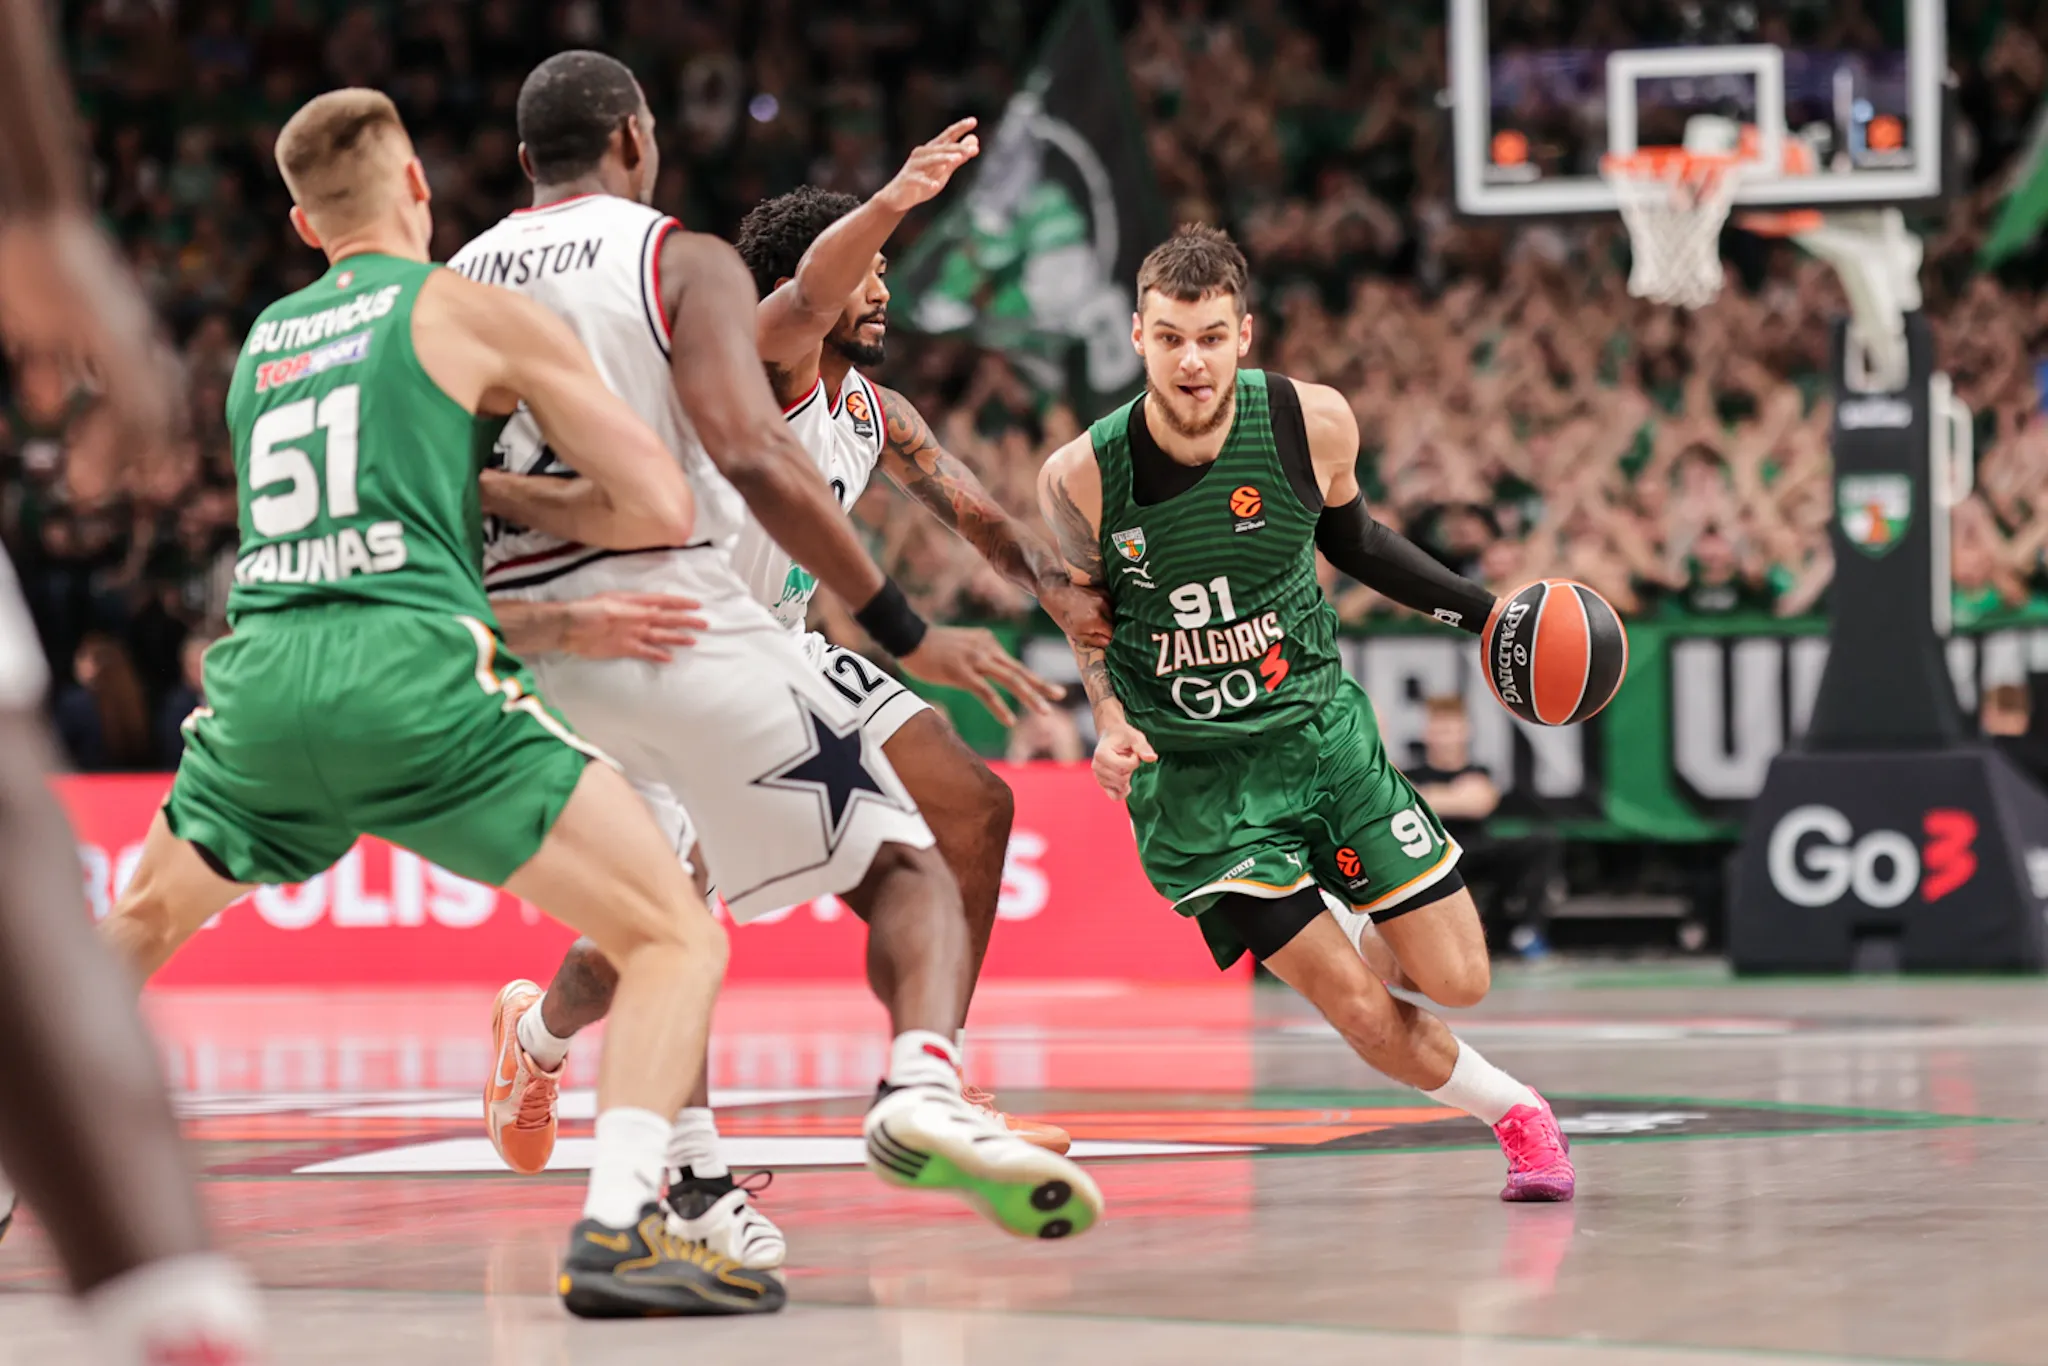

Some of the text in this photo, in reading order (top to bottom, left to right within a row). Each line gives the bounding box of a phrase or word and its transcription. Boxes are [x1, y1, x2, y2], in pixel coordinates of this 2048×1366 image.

[453, 238, 603, 286] UNSTON
[249, 384, 360, 537] 51
[1168, 575, 1237, 629] 91
[1496, 601, 1531, 704] SPALDING
[821, 653, 889, 708] 12
